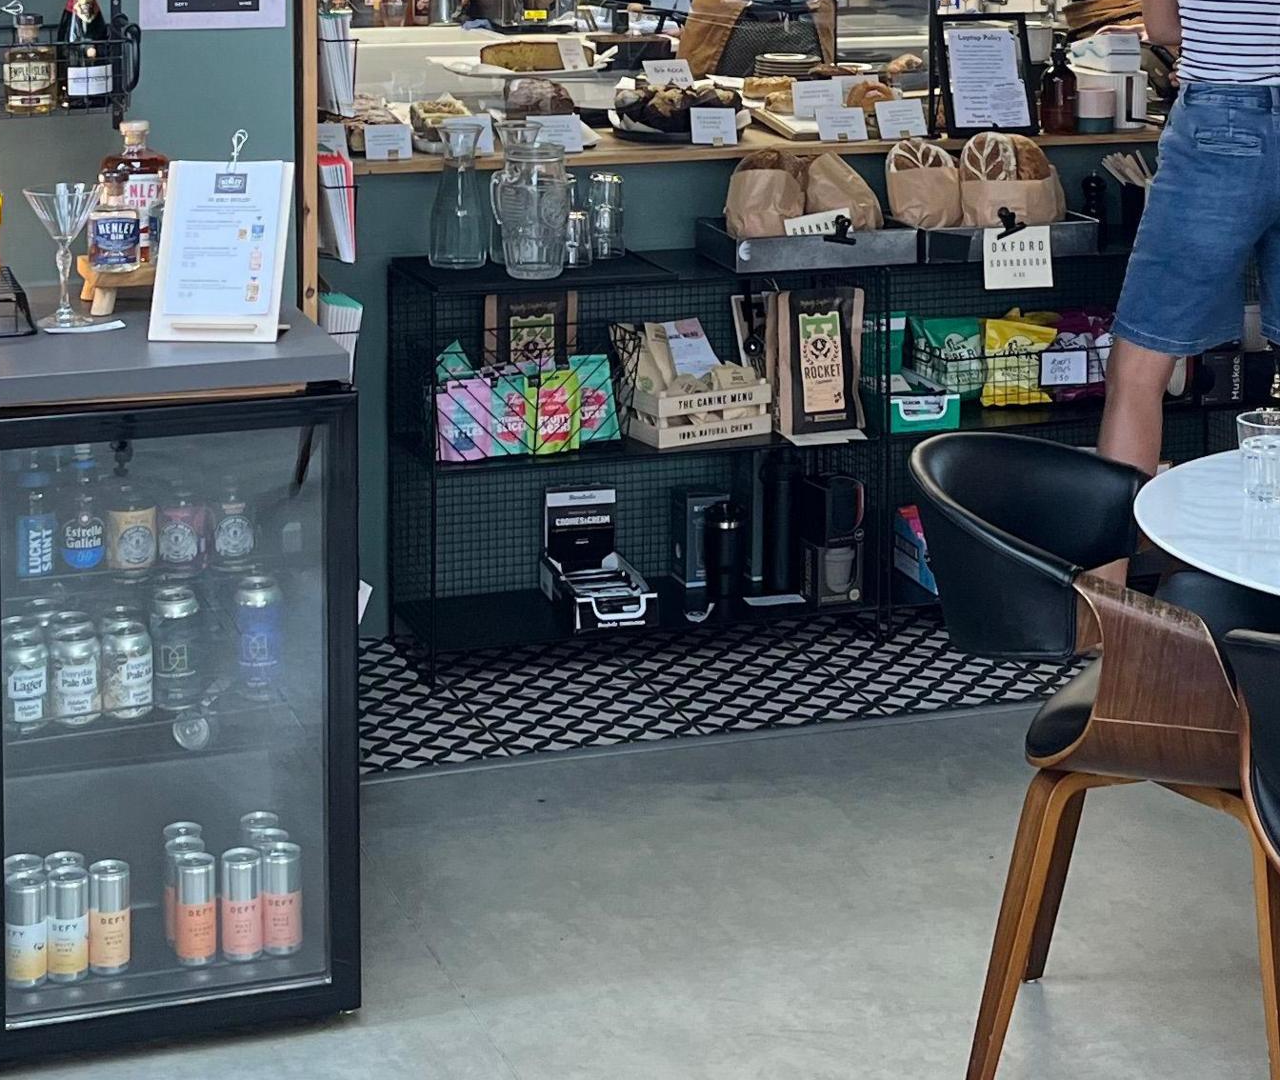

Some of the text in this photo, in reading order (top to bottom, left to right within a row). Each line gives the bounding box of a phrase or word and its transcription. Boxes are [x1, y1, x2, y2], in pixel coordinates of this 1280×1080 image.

[958, 33, 1002, 42] Laptop Policy
[129, 183, 164, 198] NLEY
[98, 222, 135, 235] HENLEY
[110, 233, 125, 241] GIN
[991, 240, 1045, 253] OXFORD
[989, 258, 1048, 268] SOURDOUGH
[804, 363, 842, 379] ROCKET
[678, 392, 754, 410] THE CANINE MENU
[678, 422, 754, 441] 100% NATURAL CHEWS
[28, 529, 41, 574] LUCKY
[42, 528, 53, 572] SAINT
[13, 679, 43, 694] Lager
[61, 678, 80, 688] Pale
[267, 899, 294, 908] DEFY
[188, 907, 214, 917] DEFY
[230, 904, 257, 914] DEFY
[100, 916, 126, 925] DEFY
[52, 924, 78, 932] DEFY
[6, 929, 25, 939] EFY
